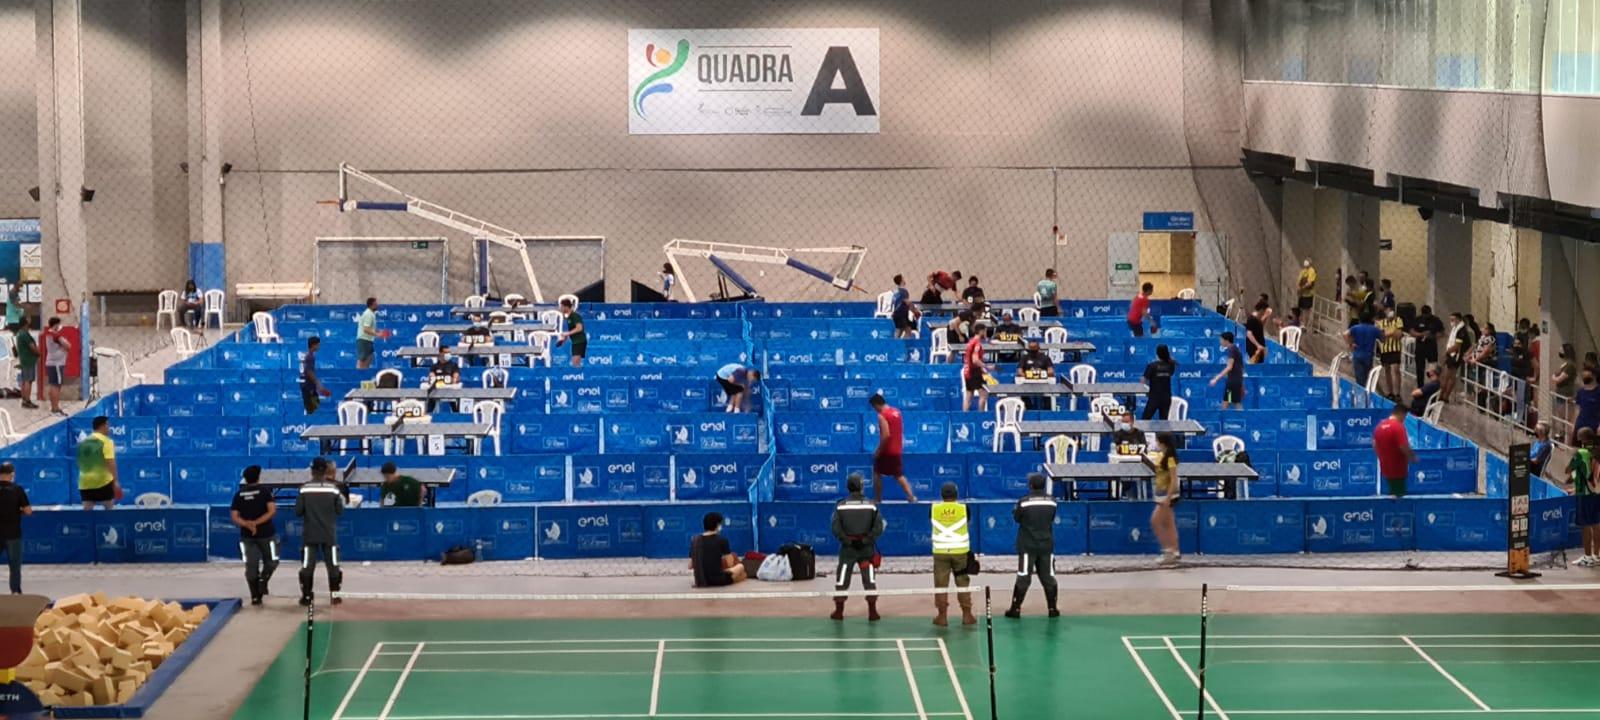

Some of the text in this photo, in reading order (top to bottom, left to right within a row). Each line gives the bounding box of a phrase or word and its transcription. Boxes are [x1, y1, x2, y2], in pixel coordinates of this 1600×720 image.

[697, 46, 878, 116] QUADRA A
[577, 386, 601, 396] enel
[700, 420, 726, 431] enel
[1346, 415, 1372, 427] enel
[607, 461, 636, 474] enel
[709, 461, 738, 474] enel
[810, 461, 839, 473] enel
[1313, 458, 1341, 471] enel
[577, 513, 609, 527] enel
[1343, 508, 1374, 522] enel
[1542, 507, 1563, 521] enel
[134, 518, 167, 532] enel
